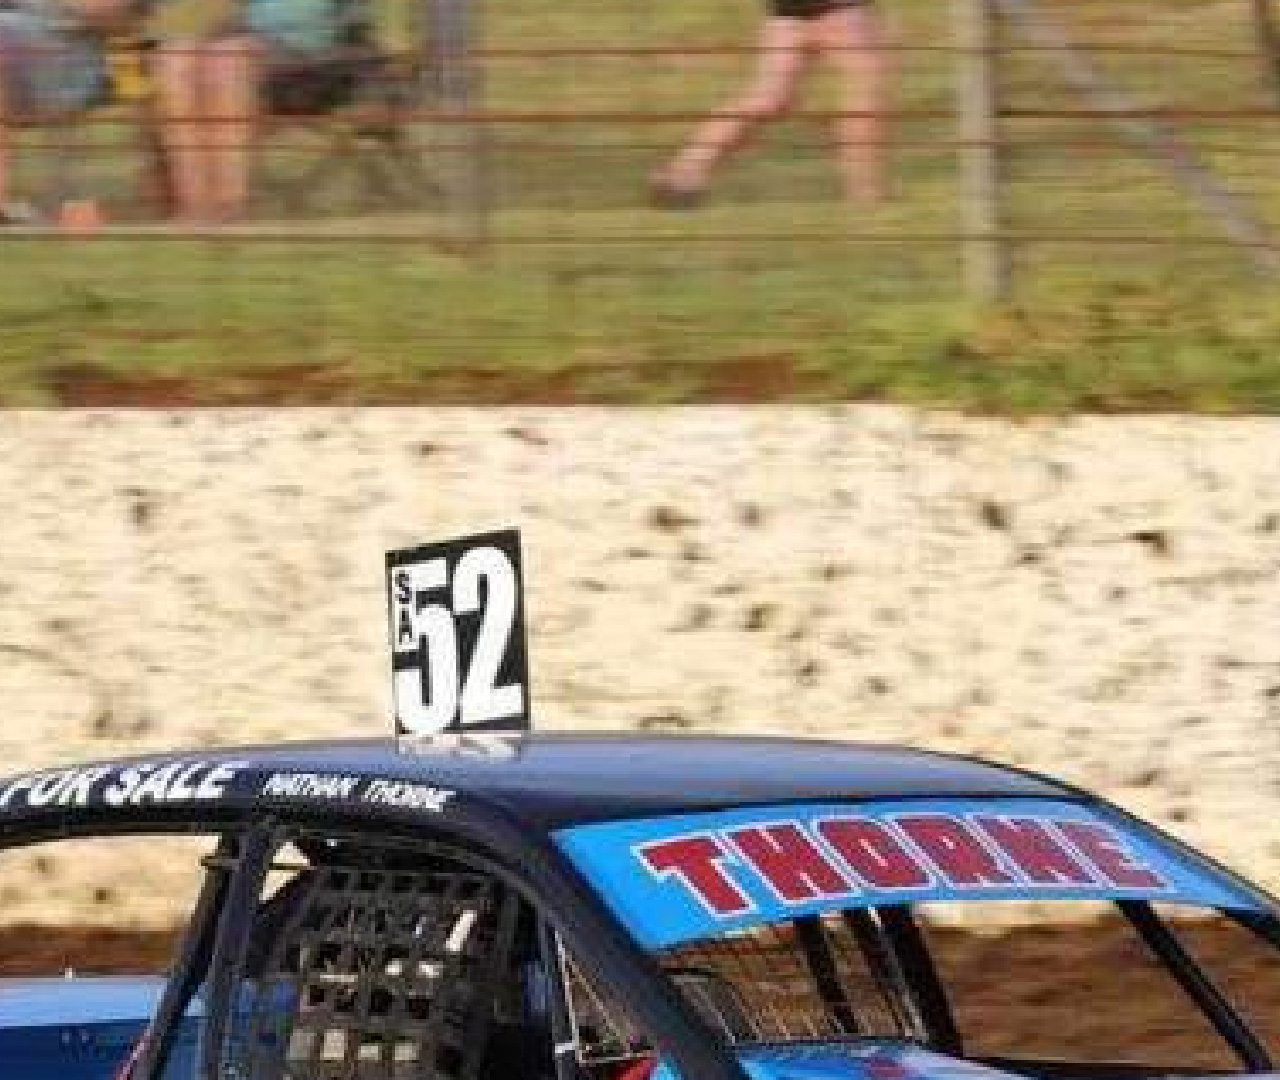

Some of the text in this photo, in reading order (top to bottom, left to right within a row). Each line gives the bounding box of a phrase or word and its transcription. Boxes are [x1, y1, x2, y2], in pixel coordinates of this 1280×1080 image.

[392, 546, 523, 736] 52
[104, 760, 250, 804] SALE
[634, 814, 1174, 919] THORNE
